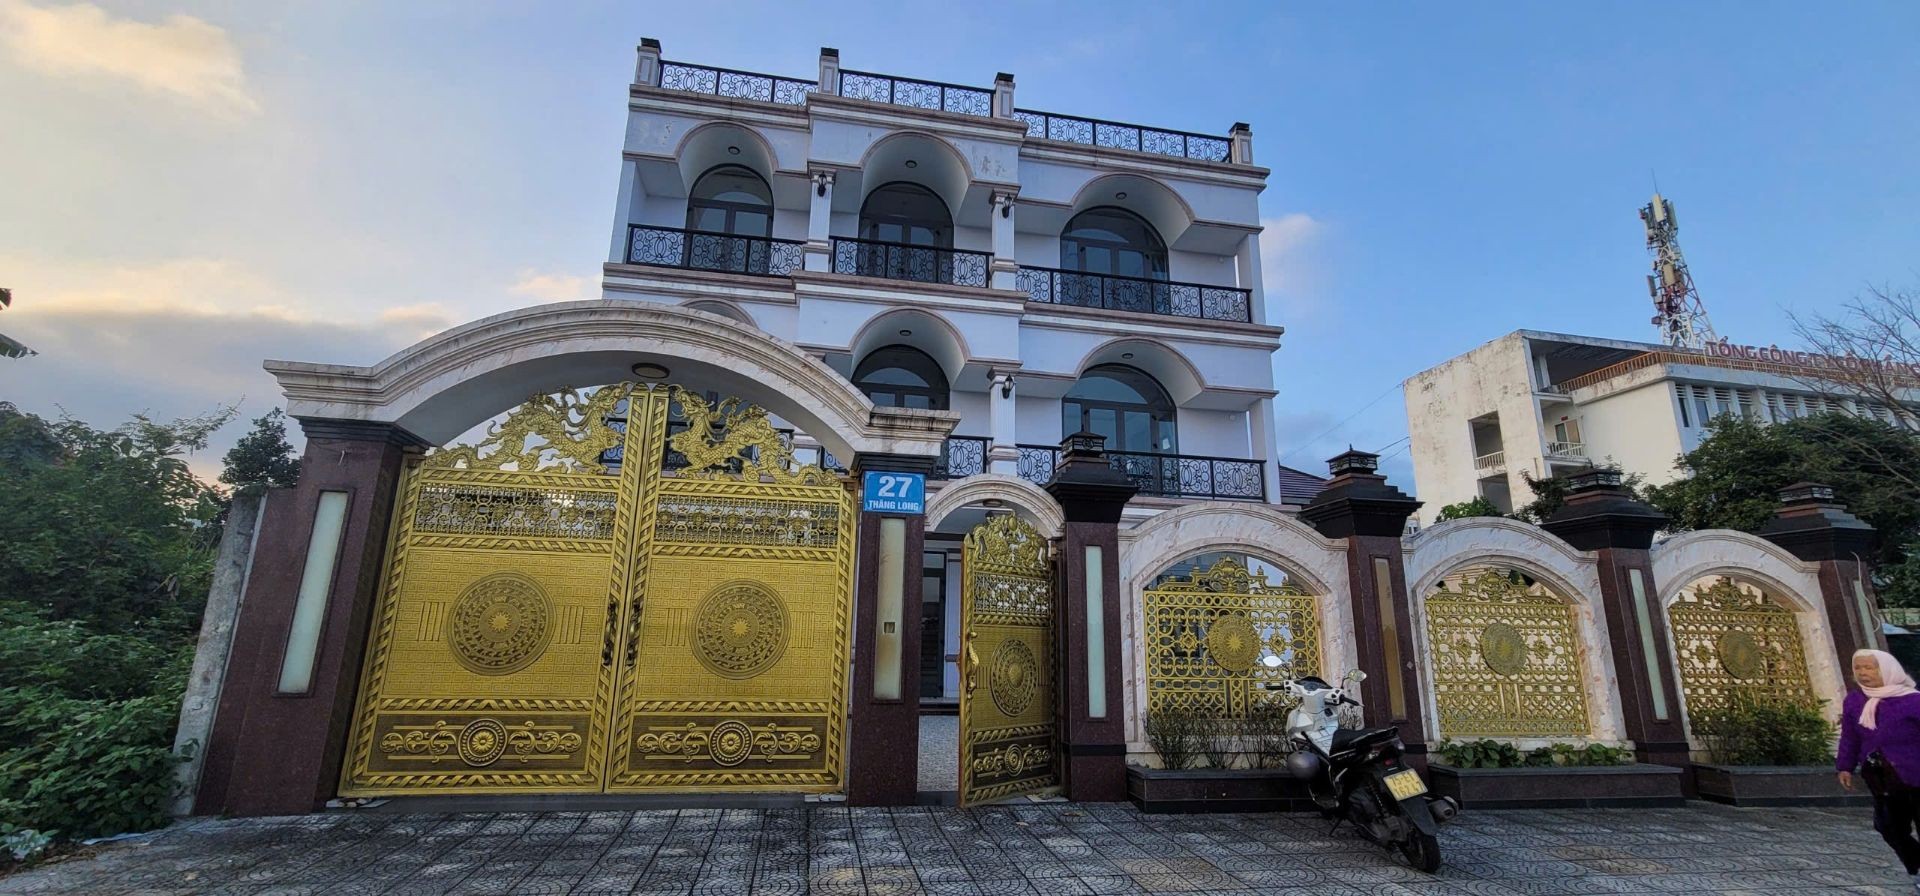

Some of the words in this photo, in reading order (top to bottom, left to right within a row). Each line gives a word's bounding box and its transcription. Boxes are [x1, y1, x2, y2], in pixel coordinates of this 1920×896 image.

[1704, 336, 1756, 359] TỔNG
[1759, 344, 1807, 365] CÔNG
[878, 475, 913, 498] 27
[897, 501, 919, 511] LONG
